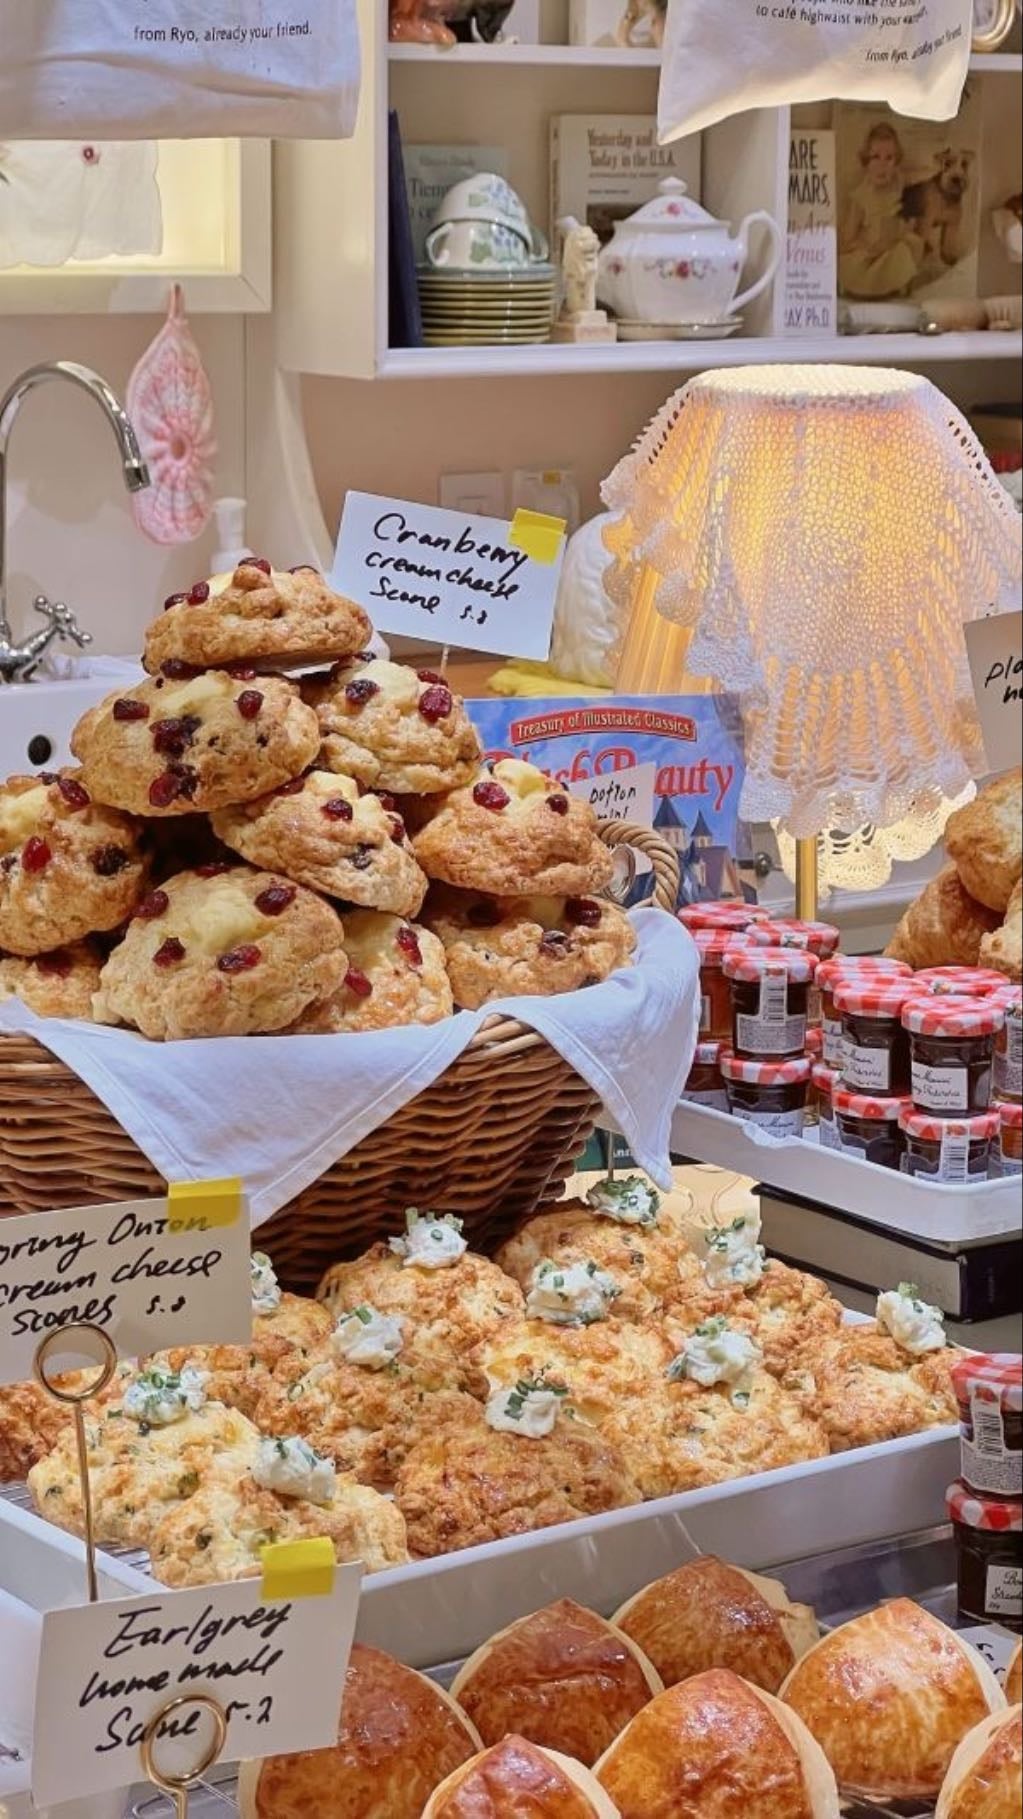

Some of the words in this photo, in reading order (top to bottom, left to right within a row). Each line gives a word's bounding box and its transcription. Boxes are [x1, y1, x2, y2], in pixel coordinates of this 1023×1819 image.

[756, 5, 769, 17] to
[800, 8, 851, 26] highwaist
[854, 12, 879, 26] with
[133, 24, 166, 41] from
[170, 26, 199, 43] Ryo,
[203, 24, 247, 43] already
[249, 26, 274, 43] your
[276, 20, 313, 37] friend.
[589, 149, 618, 170] Today
[633, 149, 648, 167] the
[788, 138, 818, 170] ARE
[516, 717, 565, 739] Treasury
[567, 712, 581, 728] of
[583, 710, 642, 727] Illustrated
[644, 713, 691, 736] Classics
[110, 1246, 223, 1283] cheese
[103, 1602, 293, 1658] Earlgrey
[78, 1671, 170, 1708] home
